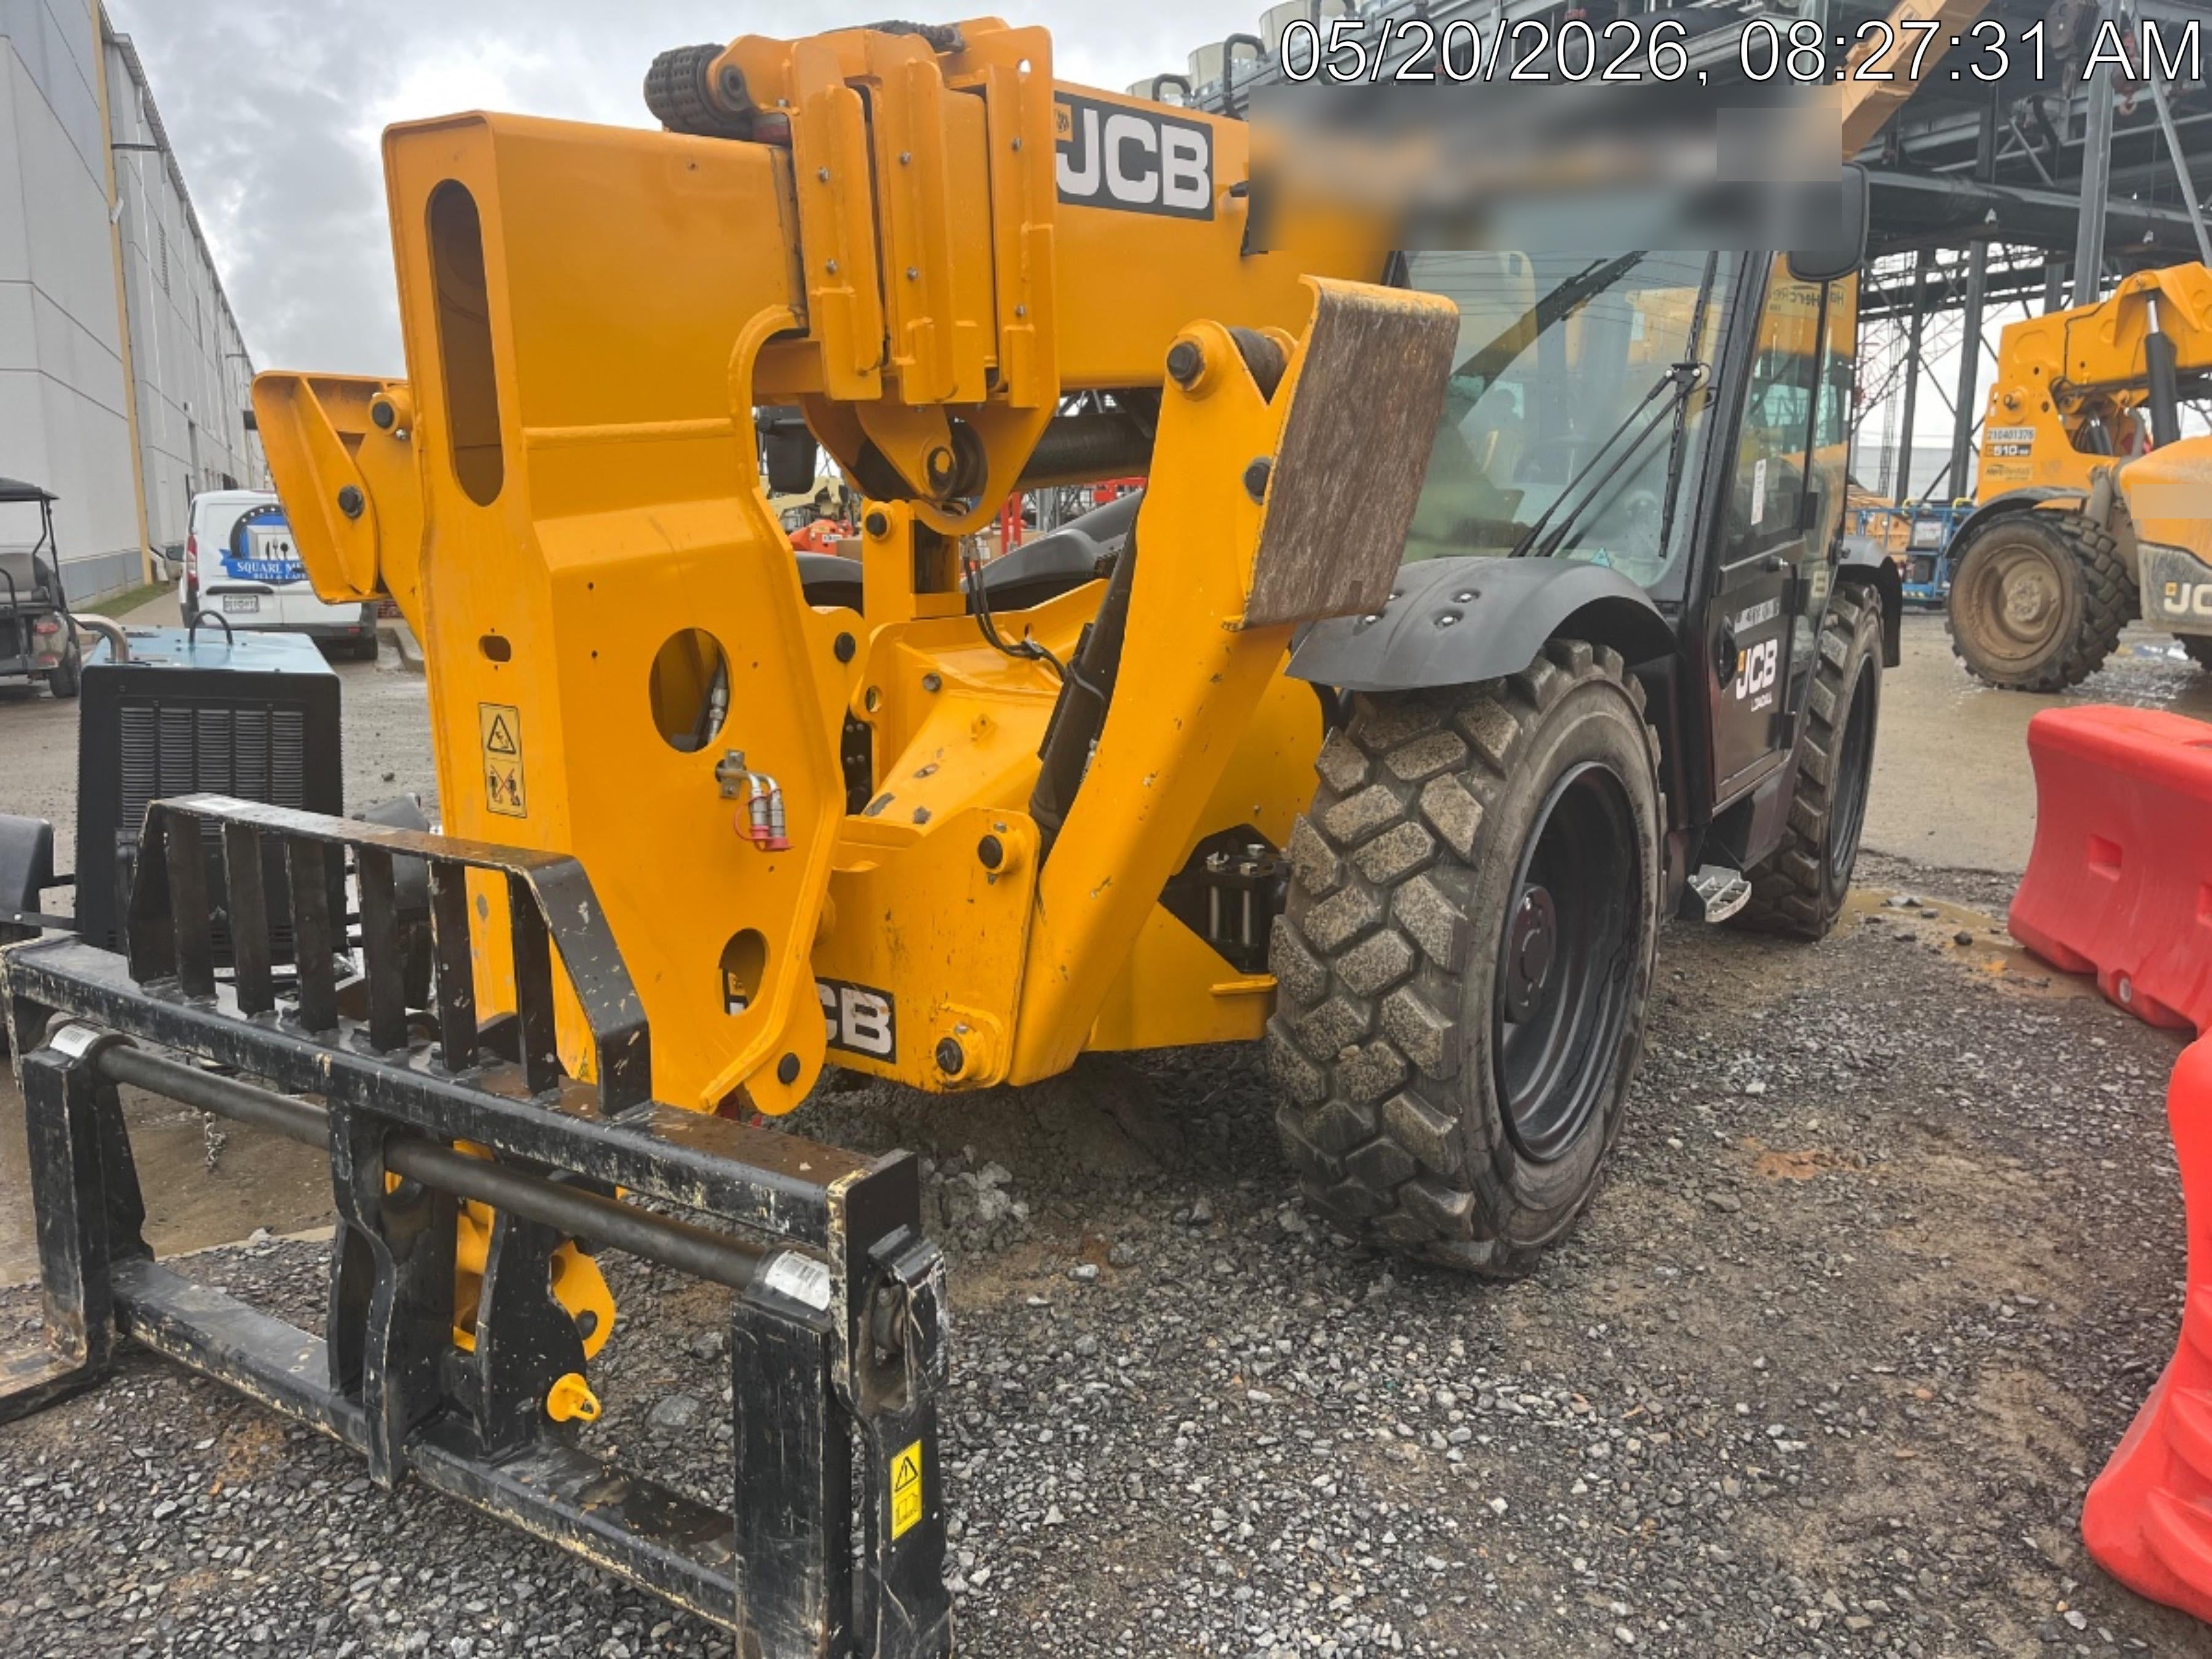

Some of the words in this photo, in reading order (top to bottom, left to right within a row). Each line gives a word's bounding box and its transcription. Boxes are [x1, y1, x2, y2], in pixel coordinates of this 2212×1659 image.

[1055, 108, 1210, 210] JCB
[237, 562, 283, 574] SQUARE
[1736, 639, 1778, 700] JCB
